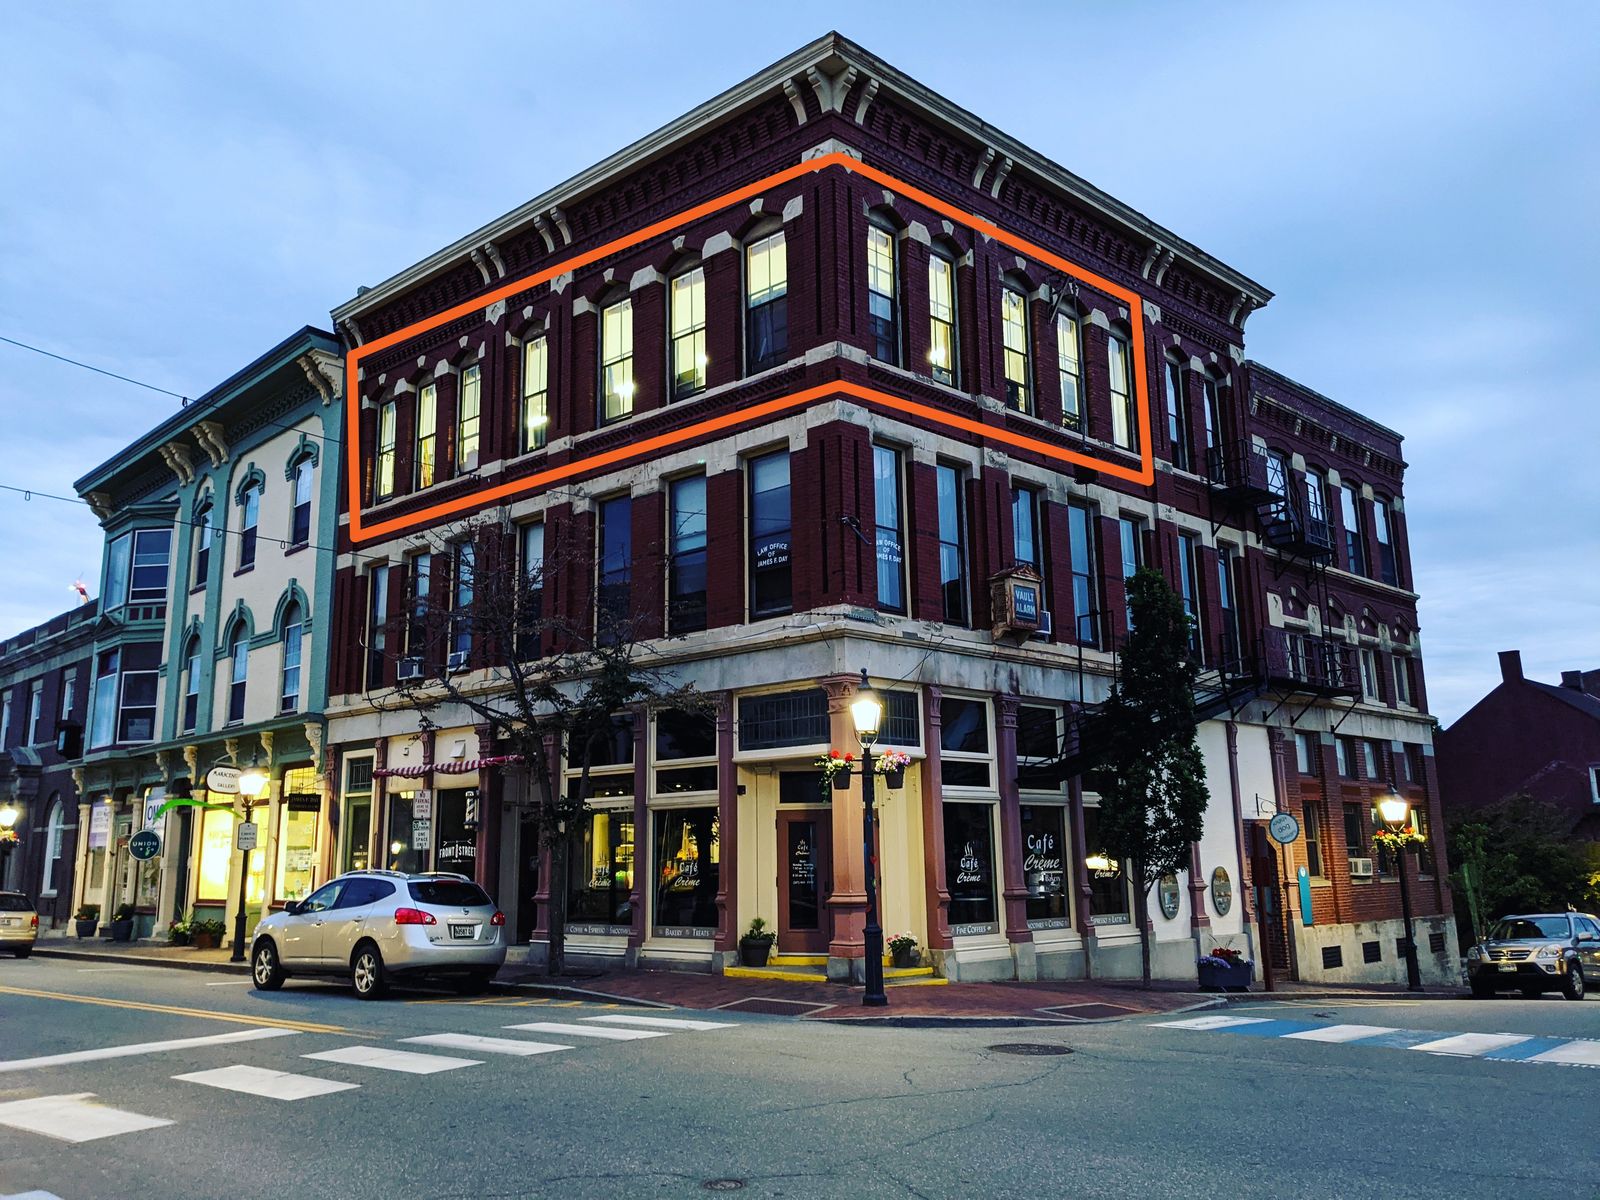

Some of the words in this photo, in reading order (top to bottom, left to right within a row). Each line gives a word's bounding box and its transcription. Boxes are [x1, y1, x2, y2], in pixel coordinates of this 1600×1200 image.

[757, 546, 768, 556] LAW
[883, 540, 901, 551] OFFICE
[757, 558, 773, 567] JAMES
[778, 555, 788, 563] DAY
[1015, 590, 1034, 602] VAULT
[1016, 603, 1036, 615] ALARM
[1027, 834, 1054, 854] Café
[439, 846, 455, 858] FRONT
[459, 845, 477, 857] STREET
[961, 858, 978, 872] Café
[1024, 854, 1060, 871] Crème
[680, 862, 698, 876] Café
[589, 877, 611, 888] Crème
[674, 877, 700, 887] Crème
[957, 872, 981, 884] Crème
[665, 928, 683, 937] BAKERY
[693, 928, 710, 937] TREATS
